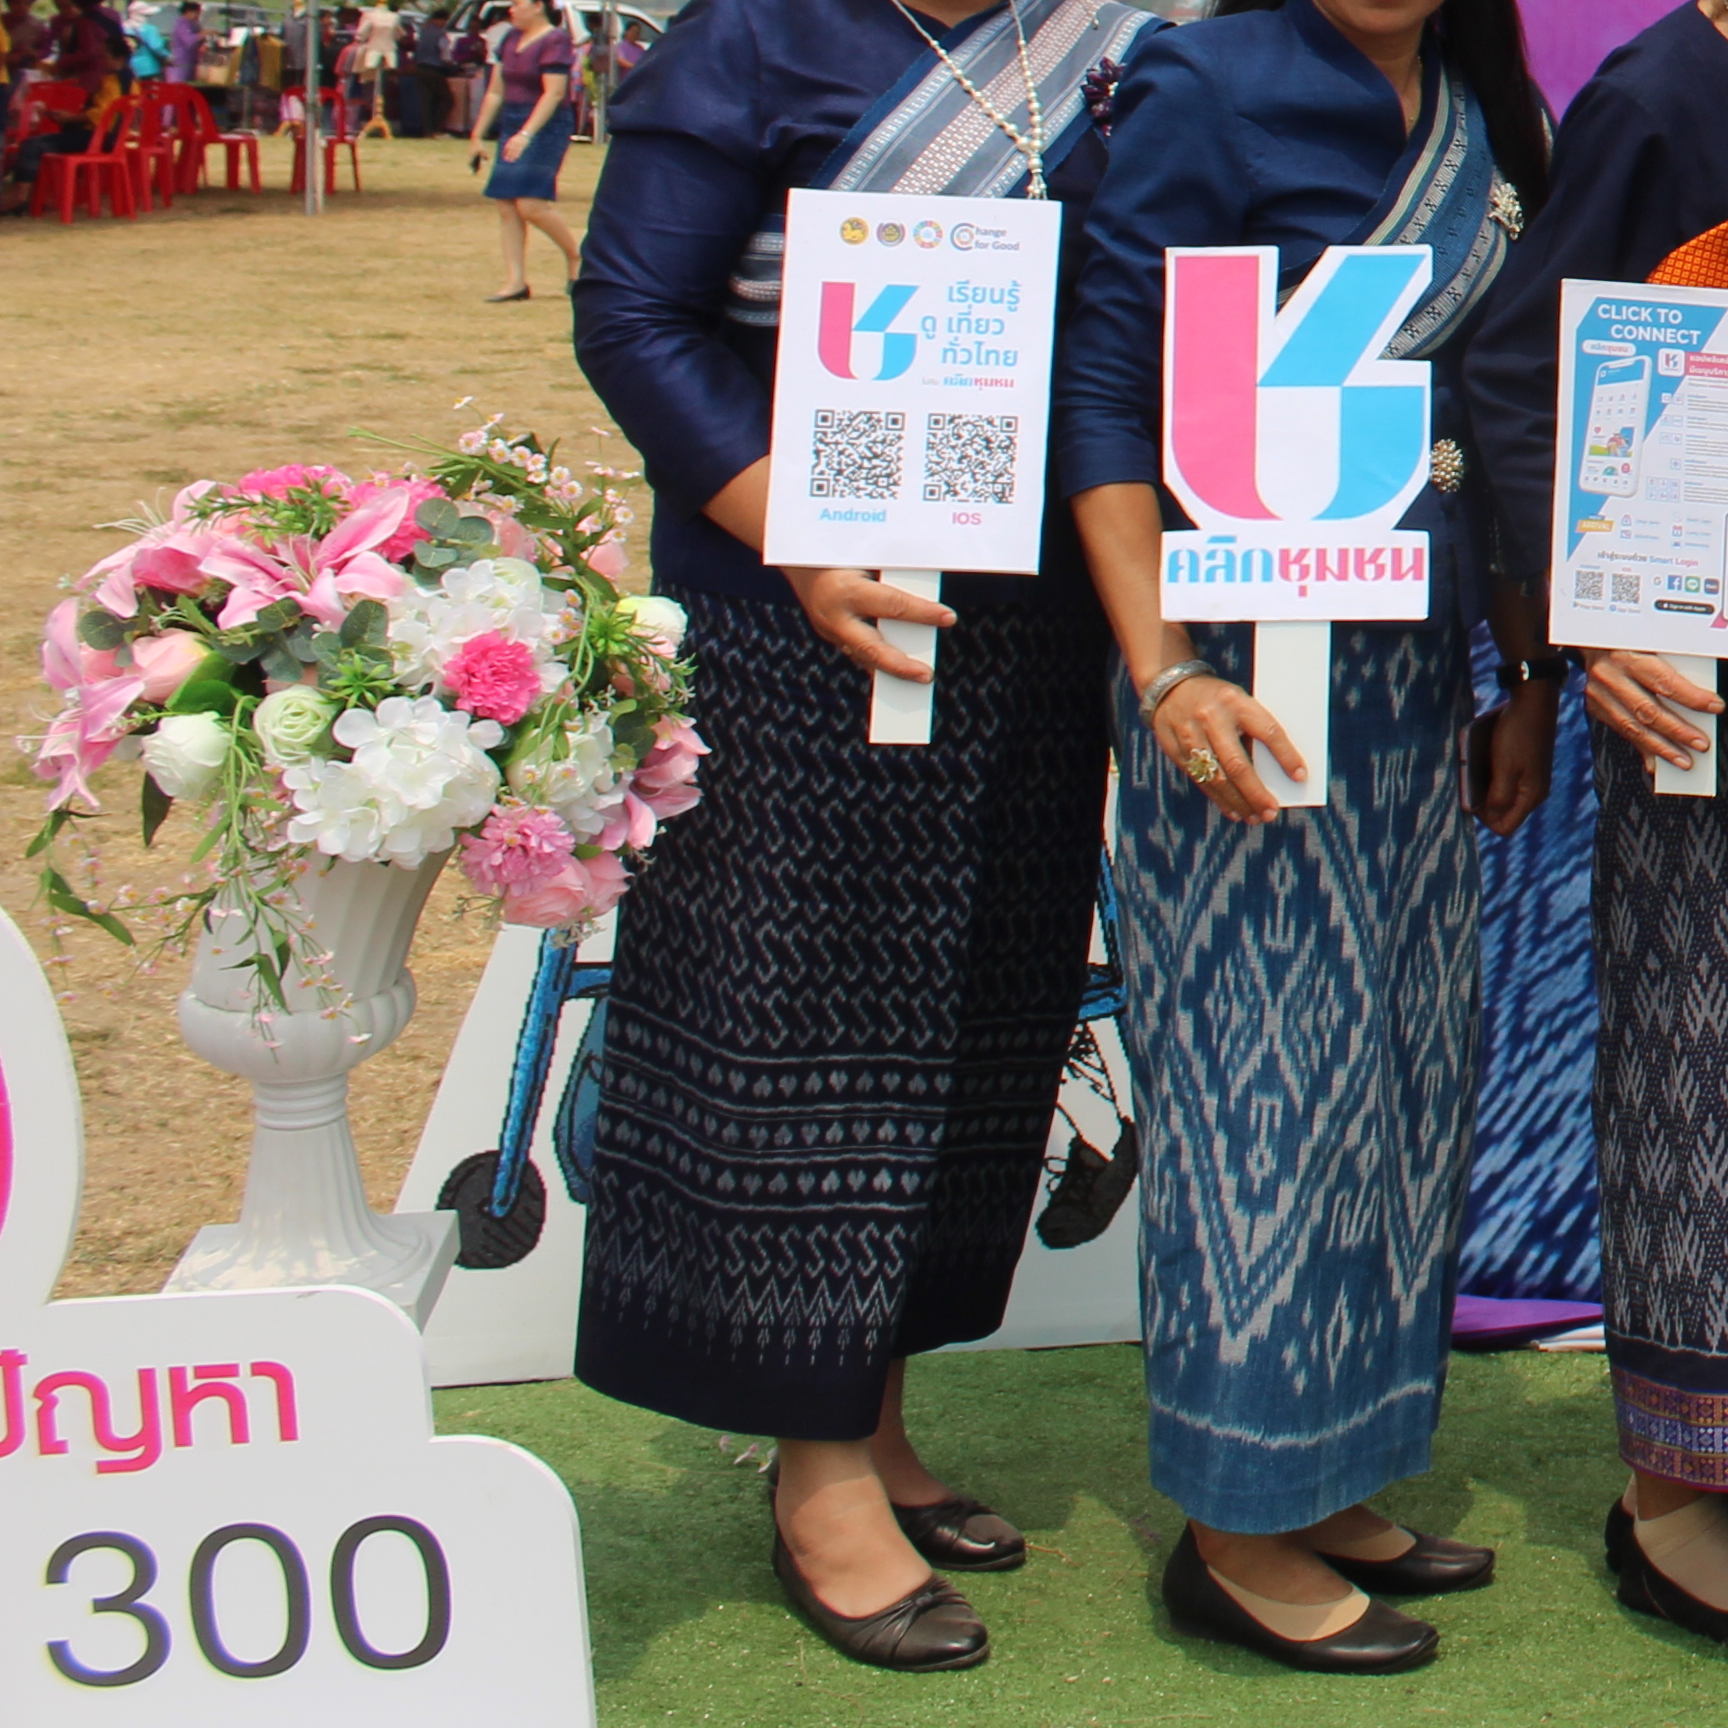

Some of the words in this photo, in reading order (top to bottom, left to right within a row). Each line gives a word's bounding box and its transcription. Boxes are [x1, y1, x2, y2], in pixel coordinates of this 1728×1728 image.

[946, 279, 1022, 313] เรียนรู้
[920, 315, 938, 340] ดู
[946, 304, 1005, 335] เที่ยว
[1597, 303, 1654, 323] CLICK
[1656, 308, 1683, 324] TO
[1610, 323, 1702, 345] CONNECT
[940, 336, 1019, 367] ทั่วไทย
[819, 508, 887, 523] Android
[951, 511, 983, 525] IOS
[1166, 535, 1425, 598] คลิกชุมชน
[45, 1513, 453, 1689] 300
